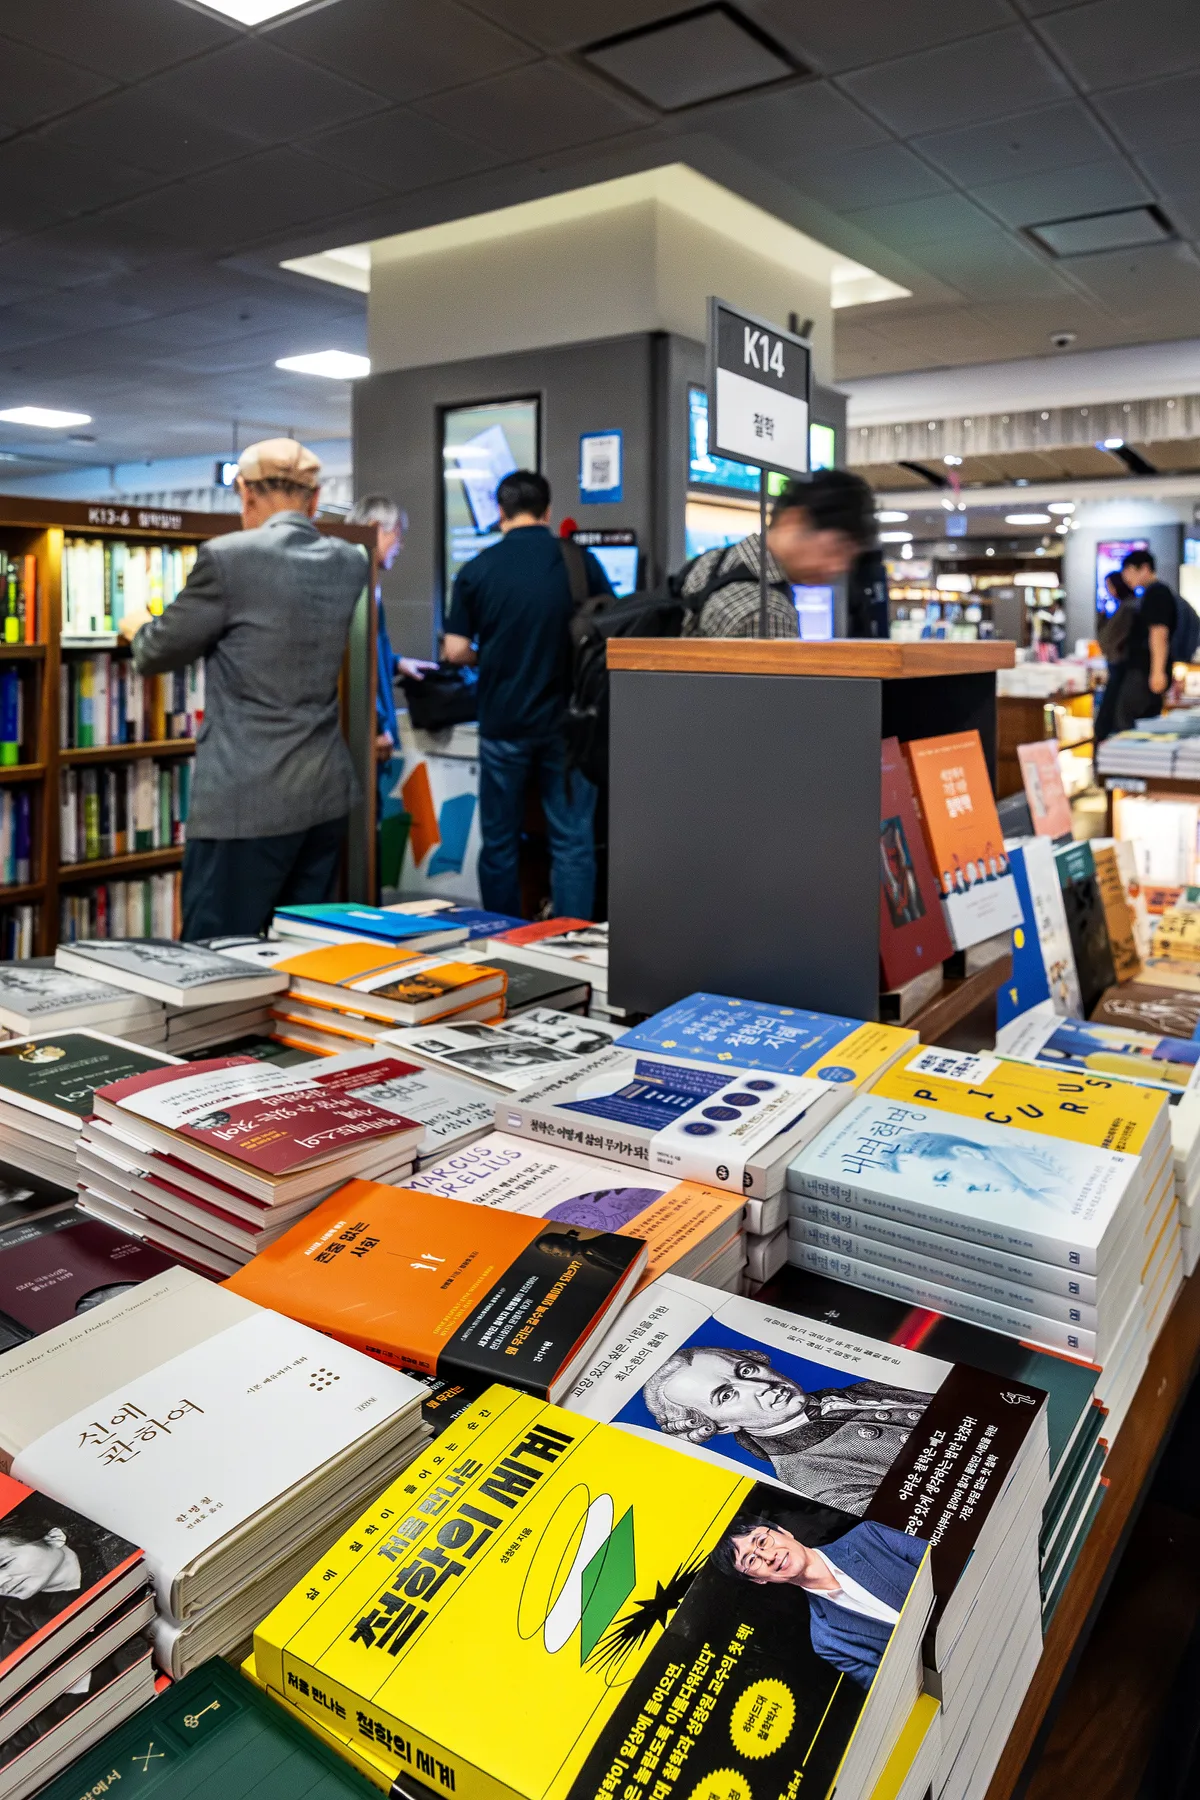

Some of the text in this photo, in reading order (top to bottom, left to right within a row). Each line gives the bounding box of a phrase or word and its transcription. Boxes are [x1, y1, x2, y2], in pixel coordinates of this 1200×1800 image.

[744, 326, 785, 378] K14
[753, 412, 775, 441] 철학
[724, 1015, 785, 1047] 철학의
[763, 1024, 810, 1050] 지혜
[254, 1107, 298, 1122] 있는
[295, 1104, 316, 1113] 수
[211, 1119, 260, 1141] 것에
[530, 1119, 557, 1136] 철학은
[556, 1126, 583, 1144] 어떻게
[585, 1131, 604, 1149] 삶의
[604, 1138, 633, 1157] 무기가
[841, 1106, 927, 1174] 내면혁명
[401, 1146, 492, 1190] MARCUS
[432, 1148, 522, 1198] URELIUS
[807, 1181, 852, 1203] 내면혁명
[806, 1203, 852, 1228] 내면혁명
[314, 1241, 346, 1264] 존중
[339, 1222, 370, 1242] 없는
[350, 1237, 381, 1258] 사회
[807, 1228, 853, 1253] 내면혁명
[806, 1253, 851, 1277] 내면혁명
[477, 1325, 499, 1348] 세계적인
[494, 1310, 511, 1328] 철학자
[505, 1260, 583, 1357] 왜 우리는 갈수록 외톨이가 되는가?
[0, 1364, 24, 1379] echen
[47, 1341, 68, 1354] Gott:
[69, 1333, 83, 1343] Ein
[84, 1318, 112, 1335] Dialog
[489, 1323, 513, 1351] 현대사회의
[570, 1305, 670, 1398] 교양 있고 싶은 사람을 위한
[614, 1332, 669, 1382] 최소한의 철학
[246, 1382, 263, 1394] 시몬
[292, 1356, 309, 1367] 대화
[425, 1385, 465, 1410] 왜 우리는
[78, 1402, 147, 1448] 신에
[97, 1398, 205, 1466] 관하여
[899, 1430, 947, 1501] 어려운 철학은 빼고
[904, 1415, 978, 1537] 교양 있게 생각하는 법만 남겼다!
[929, 1424, 999, 1547] 어디서부터 읽어야 할지 몰랐던 사람을 위한
[305, 1410, 492, 1601] 삶에 철학이 들어오는 순간
[958, 1454, 1000, 1521] 가장 부담 없는 첫 철학
[377, 1458, 483, 1563] 처음 만나는
[349, 1502, 504, 1657] 철학의
[478, 1423, 575, 1509] 세계
[500, 1527, 533, 1564] 성창원 지음
[727, 1640, 746, 1656] 첫
[735, 1622, 755, 1640] 책!
[708, 1655, 738, 1696] 교수의
[287, 1671, 456, 1792] 처음 만나는 철학의 세계
[594, 1662, 686, 1800] 철학이 일상에 들어오면,
[686, 1693, 717, 1736] 성창원
[742, 1694, 768, 1734] 하버드대
[757, 1702, 783, 1742] 철학박사
[633, 1725, 675, 1785] 놀랍도록
[661, 1735, 696, 1782] 철학과
